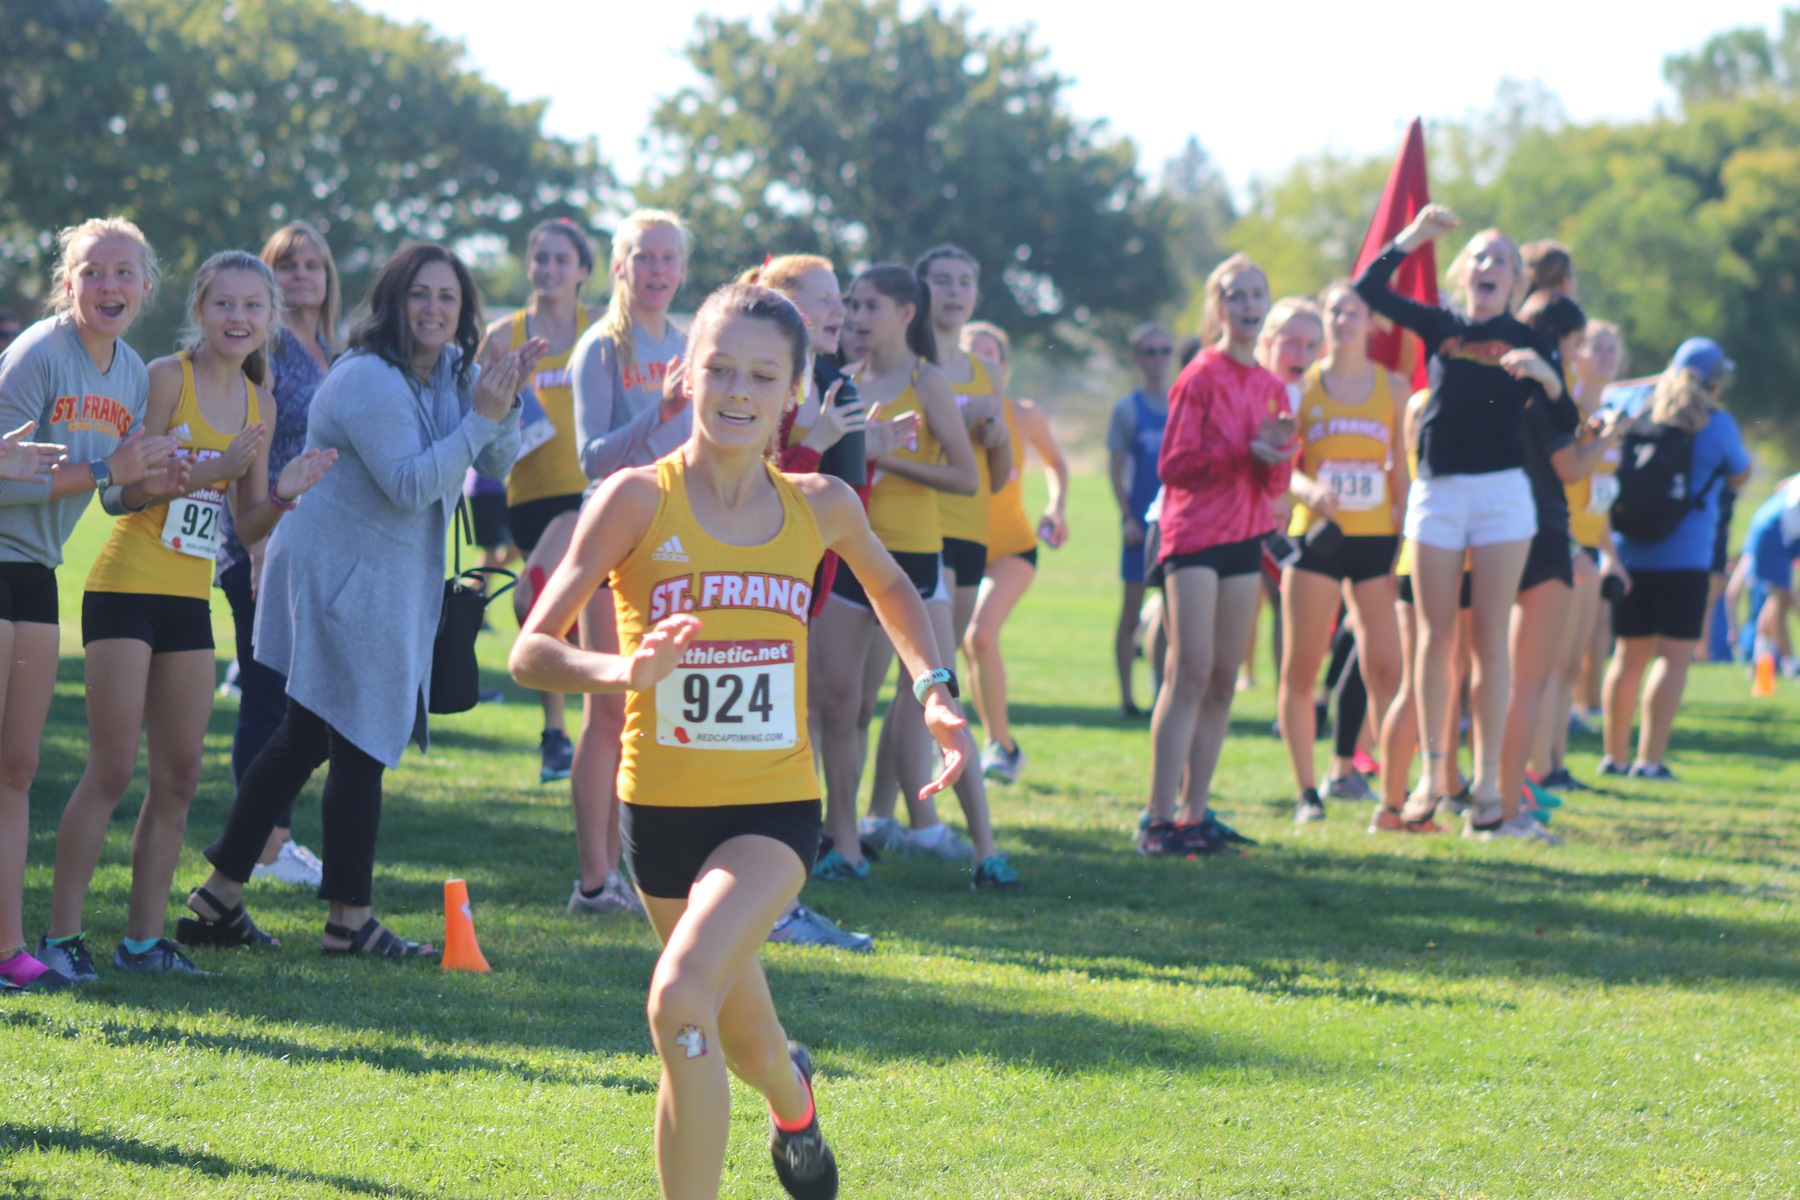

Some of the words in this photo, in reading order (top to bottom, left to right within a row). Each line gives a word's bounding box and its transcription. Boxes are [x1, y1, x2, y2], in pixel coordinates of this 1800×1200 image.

[49, 395, 79, 424] ST.
[1331, 473, 1372, 497] 938
[648, 574, 696, 624] ST.
[683, 673, 773, 723] 924
[695, 732, 784, 743] REDCAPTIMING.COM
